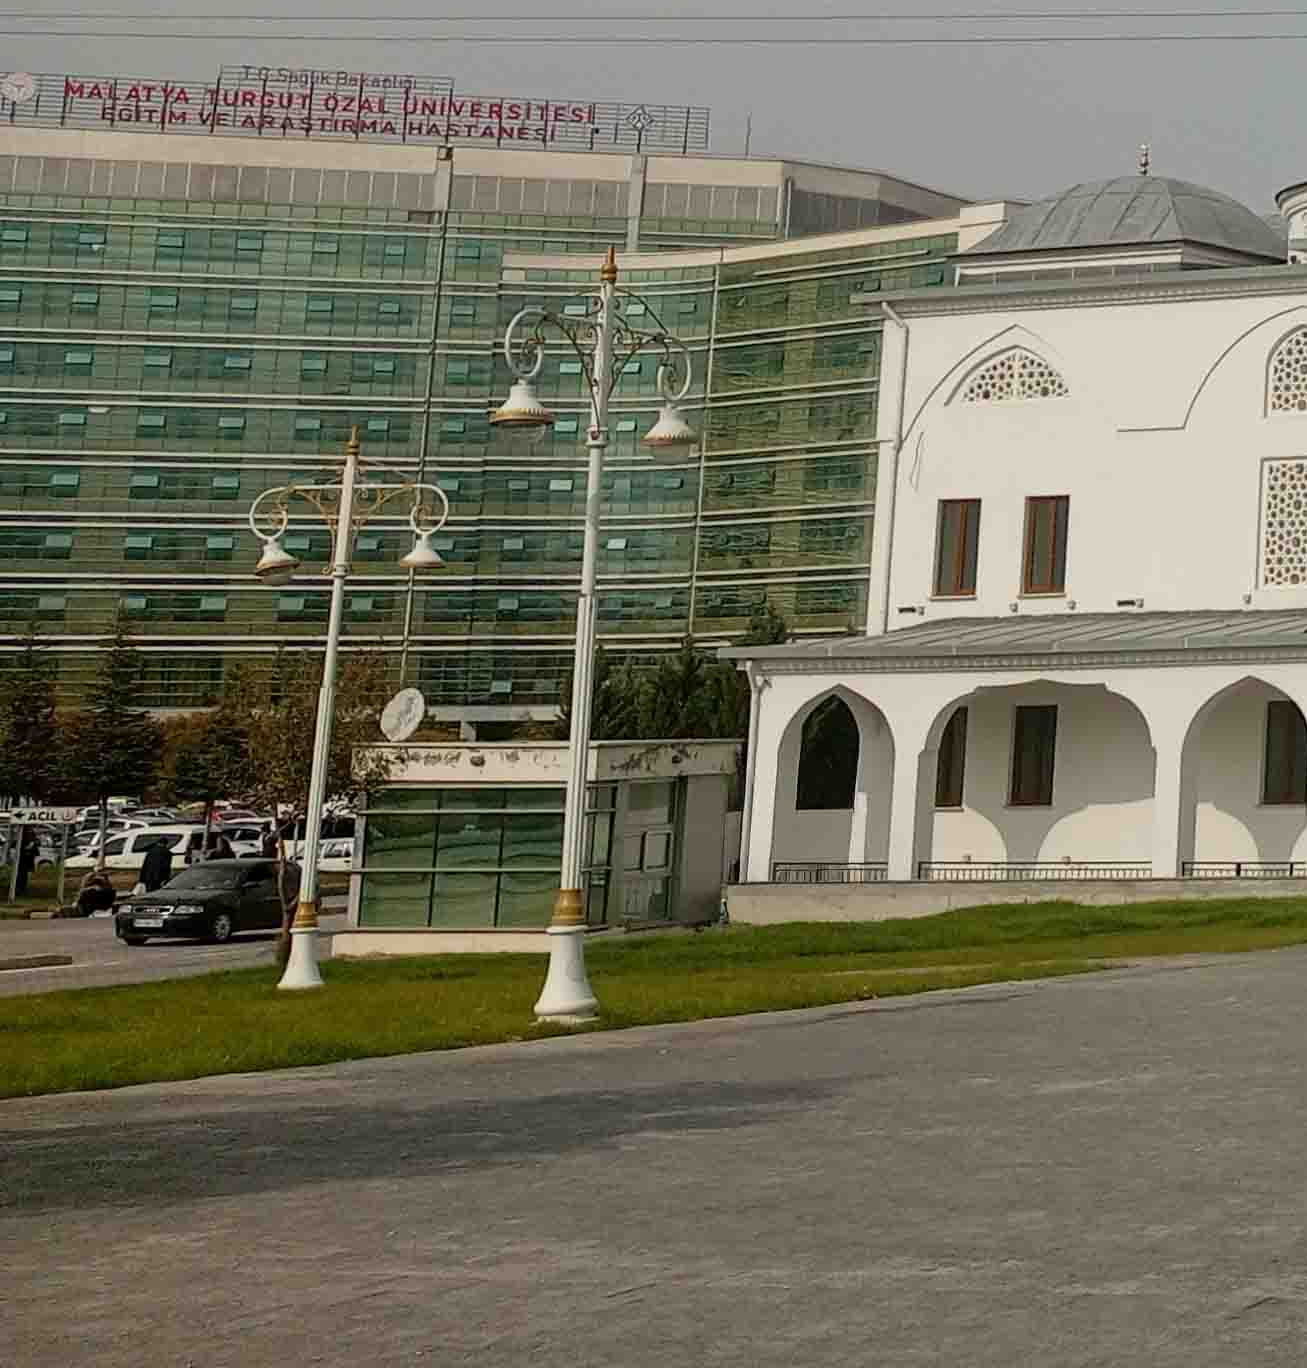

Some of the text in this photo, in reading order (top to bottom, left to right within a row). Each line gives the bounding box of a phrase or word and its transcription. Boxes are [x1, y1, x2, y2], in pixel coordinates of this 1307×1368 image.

[64, 82, 189, 105] MALATYA
[208, 89, 310, 110] TURGUT
[324, 92, 389, 114] ÖZAL
[200, 111, 231, 127] VE
